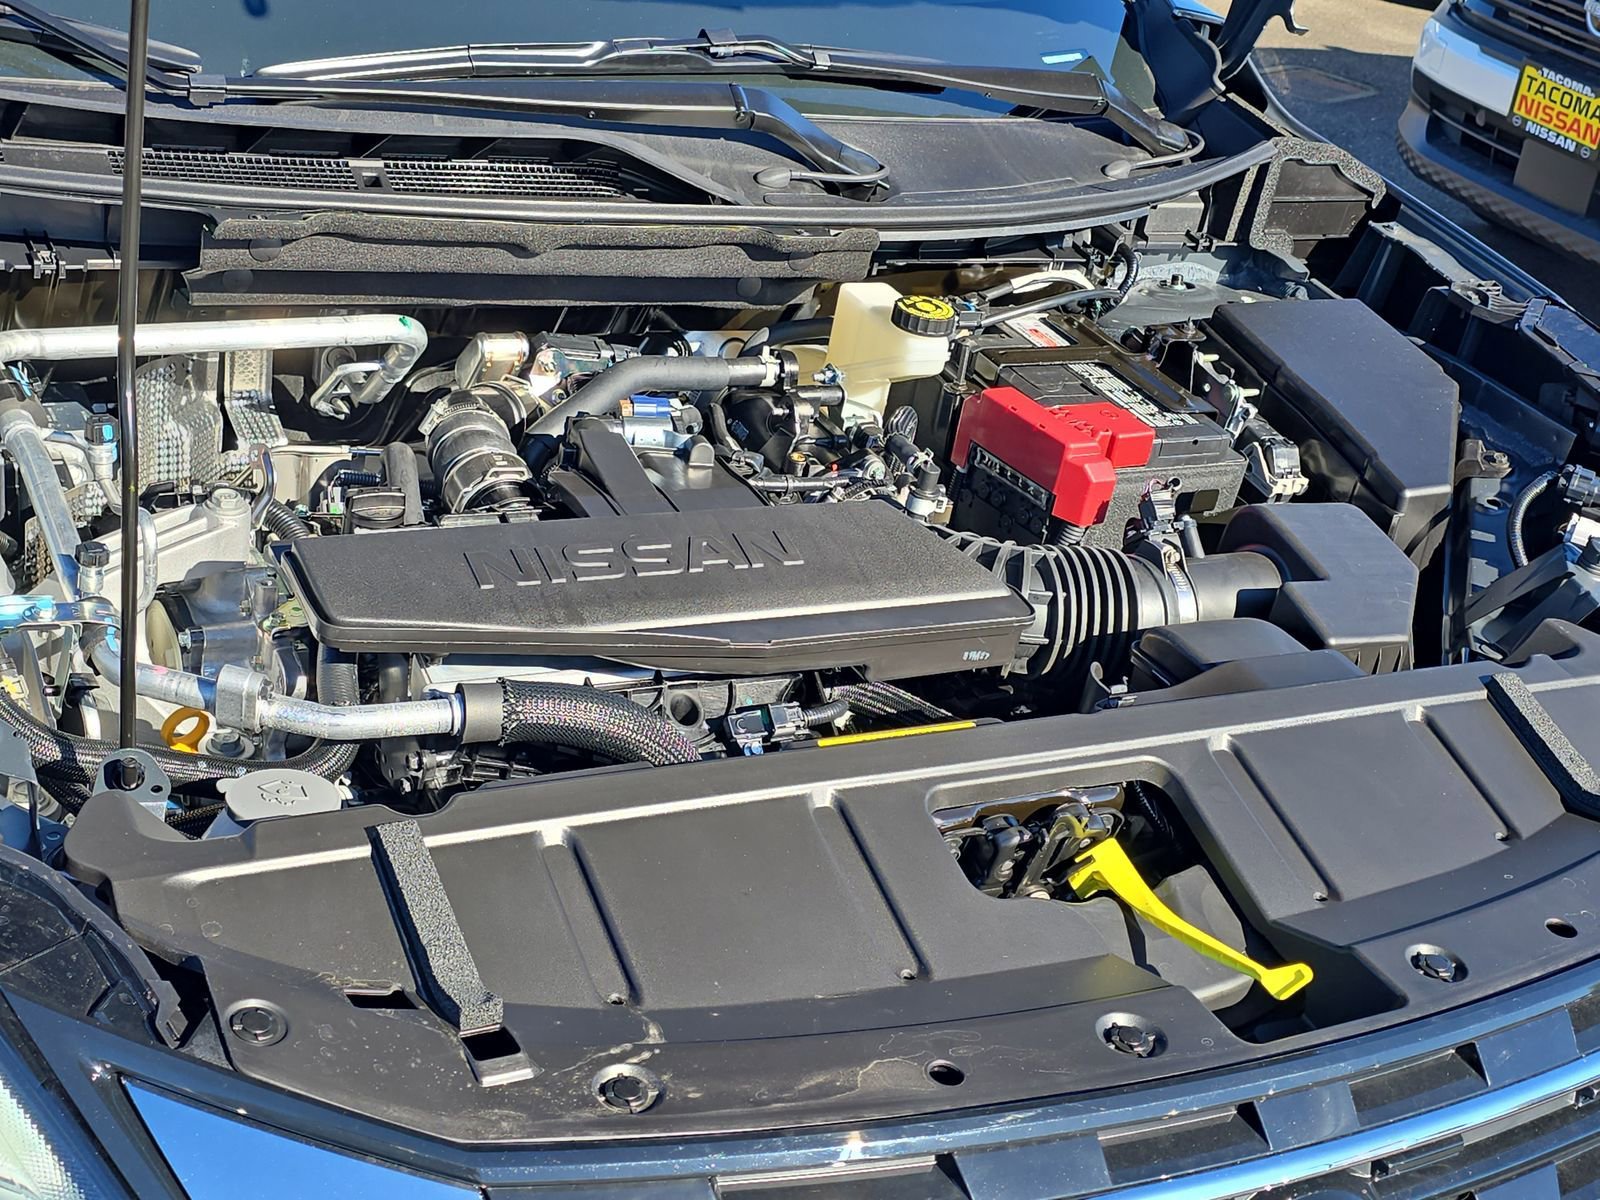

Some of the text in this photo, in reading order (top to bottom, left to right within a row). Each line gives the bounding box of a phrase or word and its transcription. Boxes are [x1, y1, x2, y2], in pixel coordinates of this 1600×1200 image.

[1526, 75, 1600, 123] TACOMA
[1541, 67, 1592, 96] TACOMA
[1517, 94, 1600, 145] NISSAN
[1525, 121, 1577, 152] NISSAN
[463, 530, 805, 589] NISSAN
